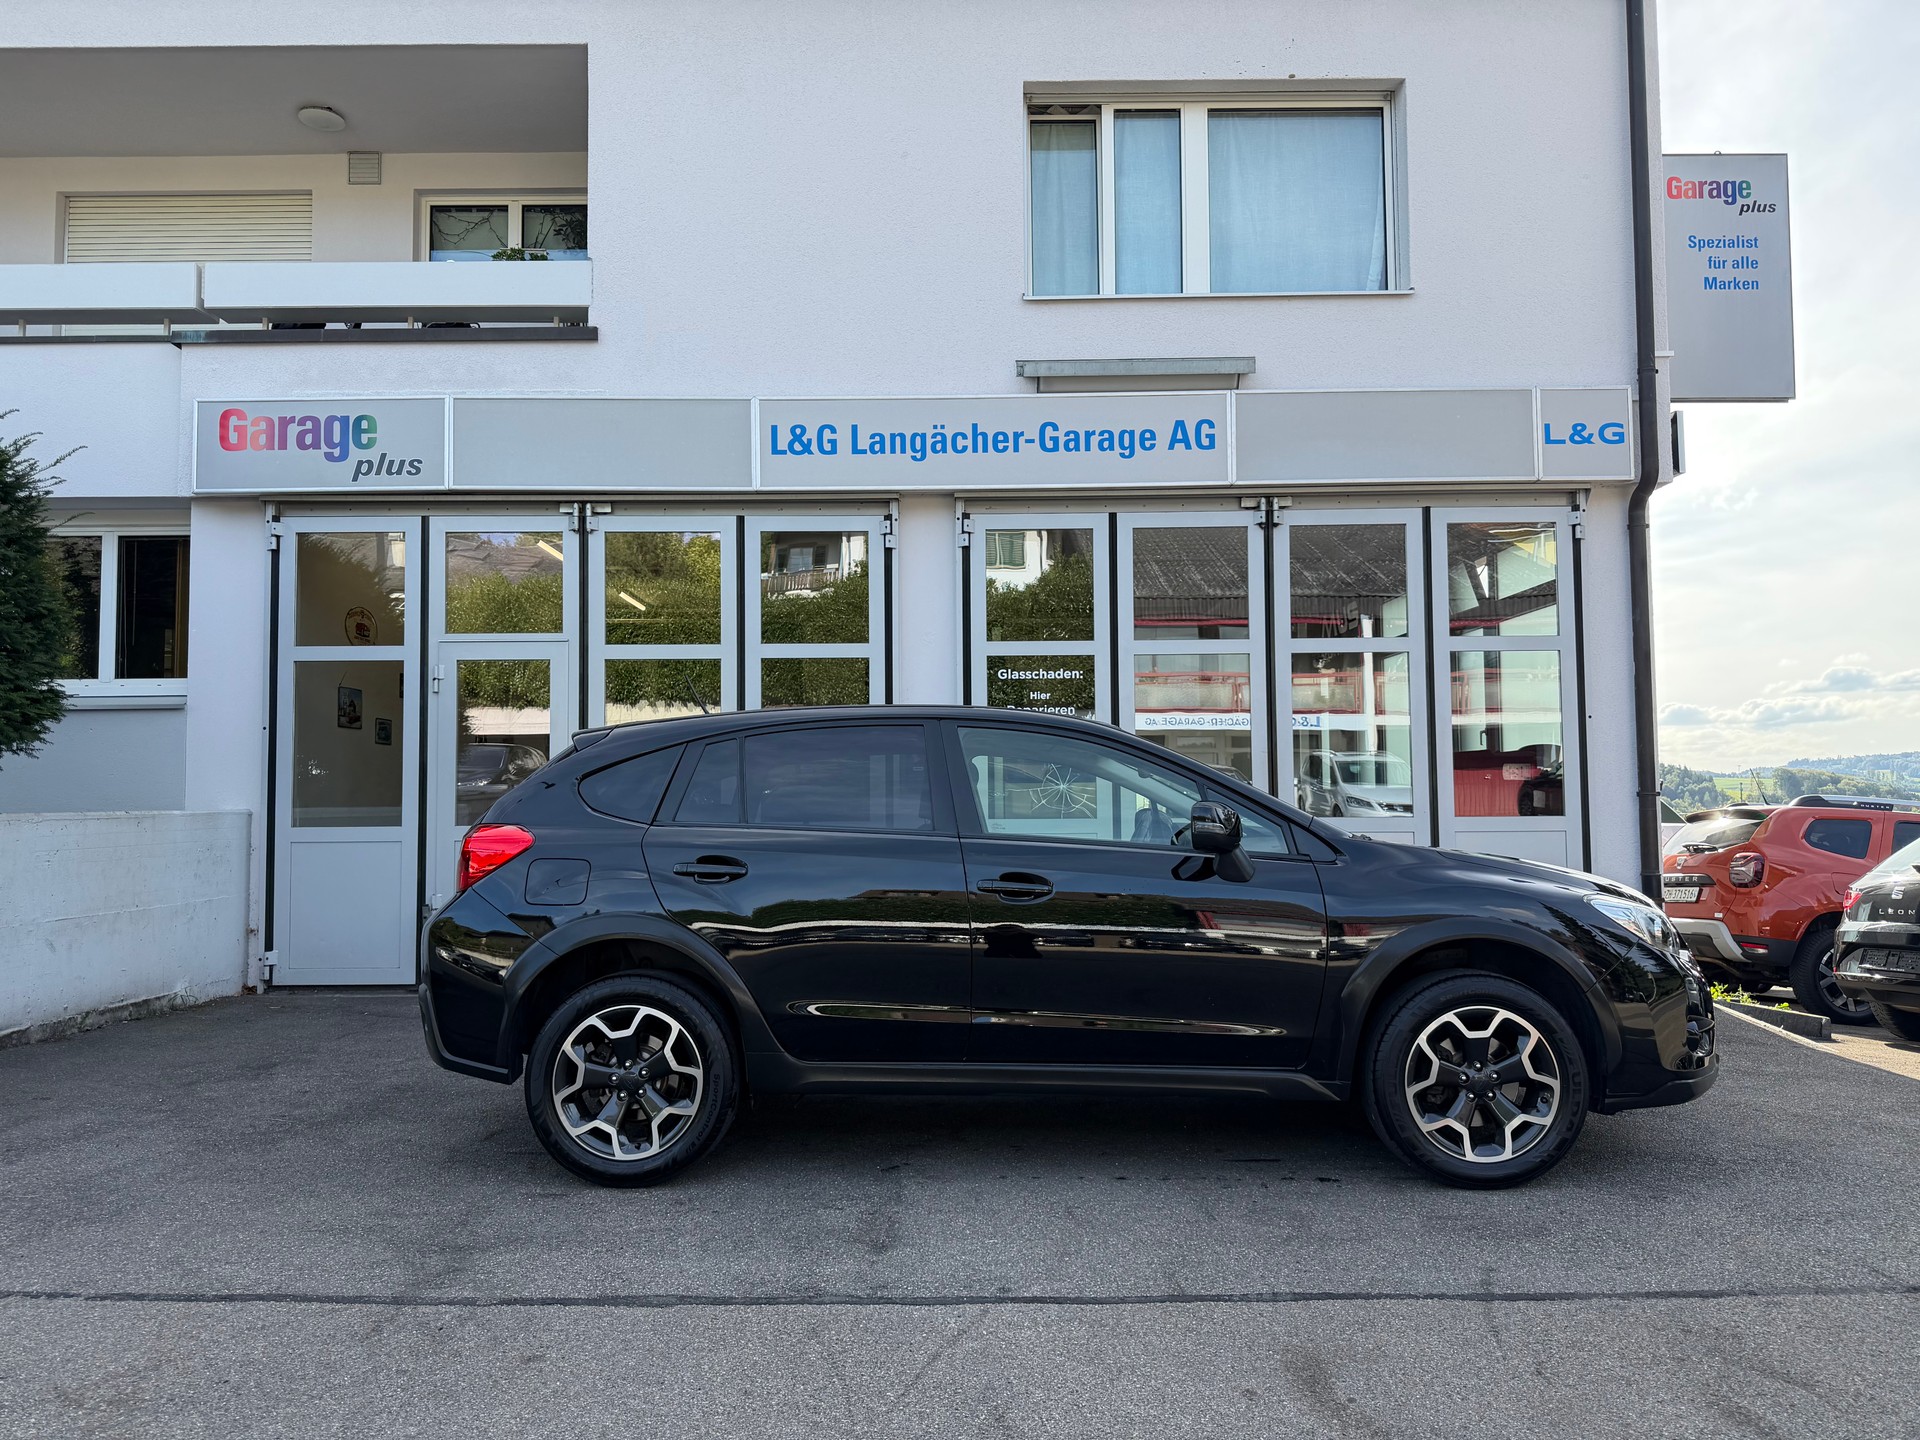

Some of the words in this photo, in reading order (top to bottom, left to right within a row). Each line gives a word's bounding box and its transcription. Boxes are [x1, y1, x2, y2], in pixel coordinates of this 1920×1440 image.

[1666, 176, 1752, 206] Garage
[1738, 200, 1777, 216] plus
[1687, 235, 1759, 252] Spezialist
[1707, 256, 1728, 269] für
[1731, 256, 1759, 269] alle
[1703, 276, 1759, 290] Marken
[218, 407, 378, 463] Garage
[770, 423, 838, 456] L&G
[850, 420, 1158, 462] Langächer-Garage
[1167, 418, 1217, 451] AG
[1544, 422, 1625, 445] L&G
[351, 452, 424, 482] plus
[997, 668, 1084, 680] Glasschaden:
[1030, 691, 1051, 700] Hier
[1878, 907, 1916, 916] LEON
